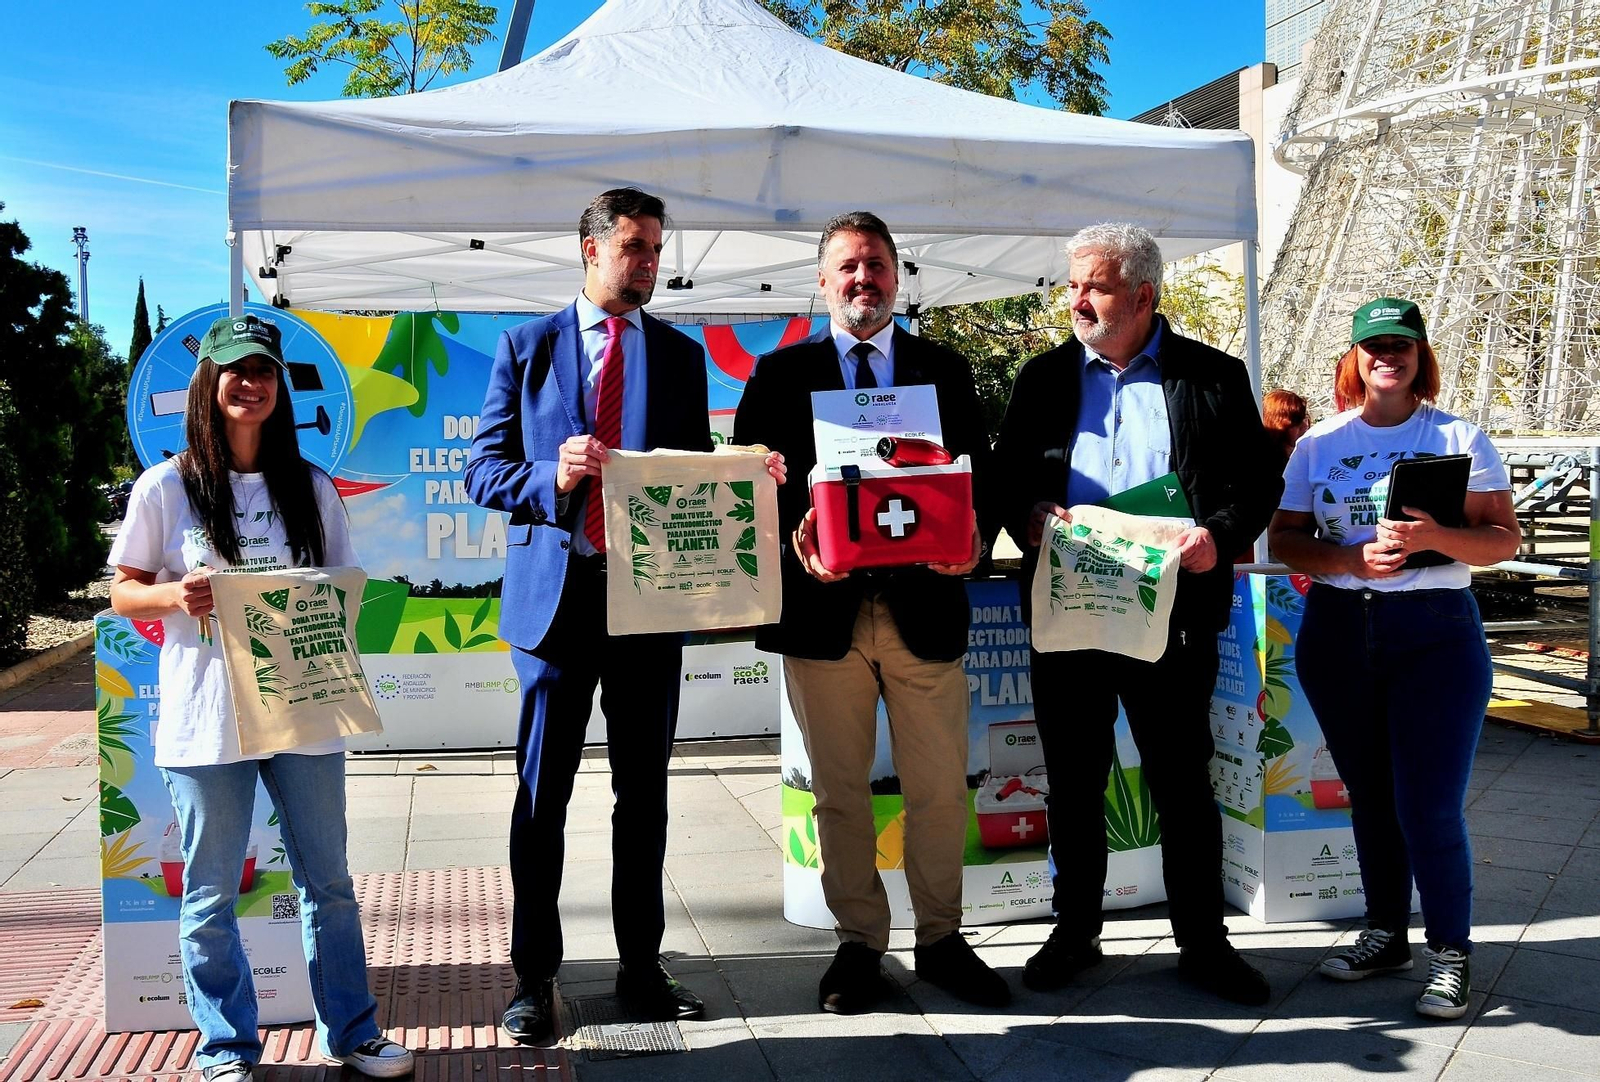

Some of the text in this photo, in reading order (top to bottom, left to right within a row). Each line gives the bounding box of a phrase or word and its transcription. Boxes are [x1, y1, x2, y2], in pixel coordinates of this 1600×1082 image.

[871, 393, 896, 403] raee
[425, 480, 476, 504] PAR
[689, 498, 707, 507] raee
[662, 519, 723, 530] ELECTRODOMÉSTICO
[427, 512, 508, 559] PLA
[667, 531, 683, 539] PARA
[249, 537, 269, 546] raee
[667, 536, 720, 552] PLANETA
[258, 556, 278, 565] VIEJO
[1074, 562, 1124, 578] PLANETA
[309, 599, 328, 608] raee
[972, 606, 1012, 624] DONA
[290, 636, 309, 646] PARA
[292, 638, 348, 661] PLANETA
[962, 649, 1031, 669] PARA DAR
[694, 672, 721, 680] ecolum
[733, 676, 769, 685] raee's
[465, 681, 501, 689] AMBILAMP
[965, 672, 1034, 706] PLAN
[1018, 734, 1036, 743] raee
[1010, 897, 1037, 906] ECOLEC
[253, 966, 287, 975] ECOLEC
